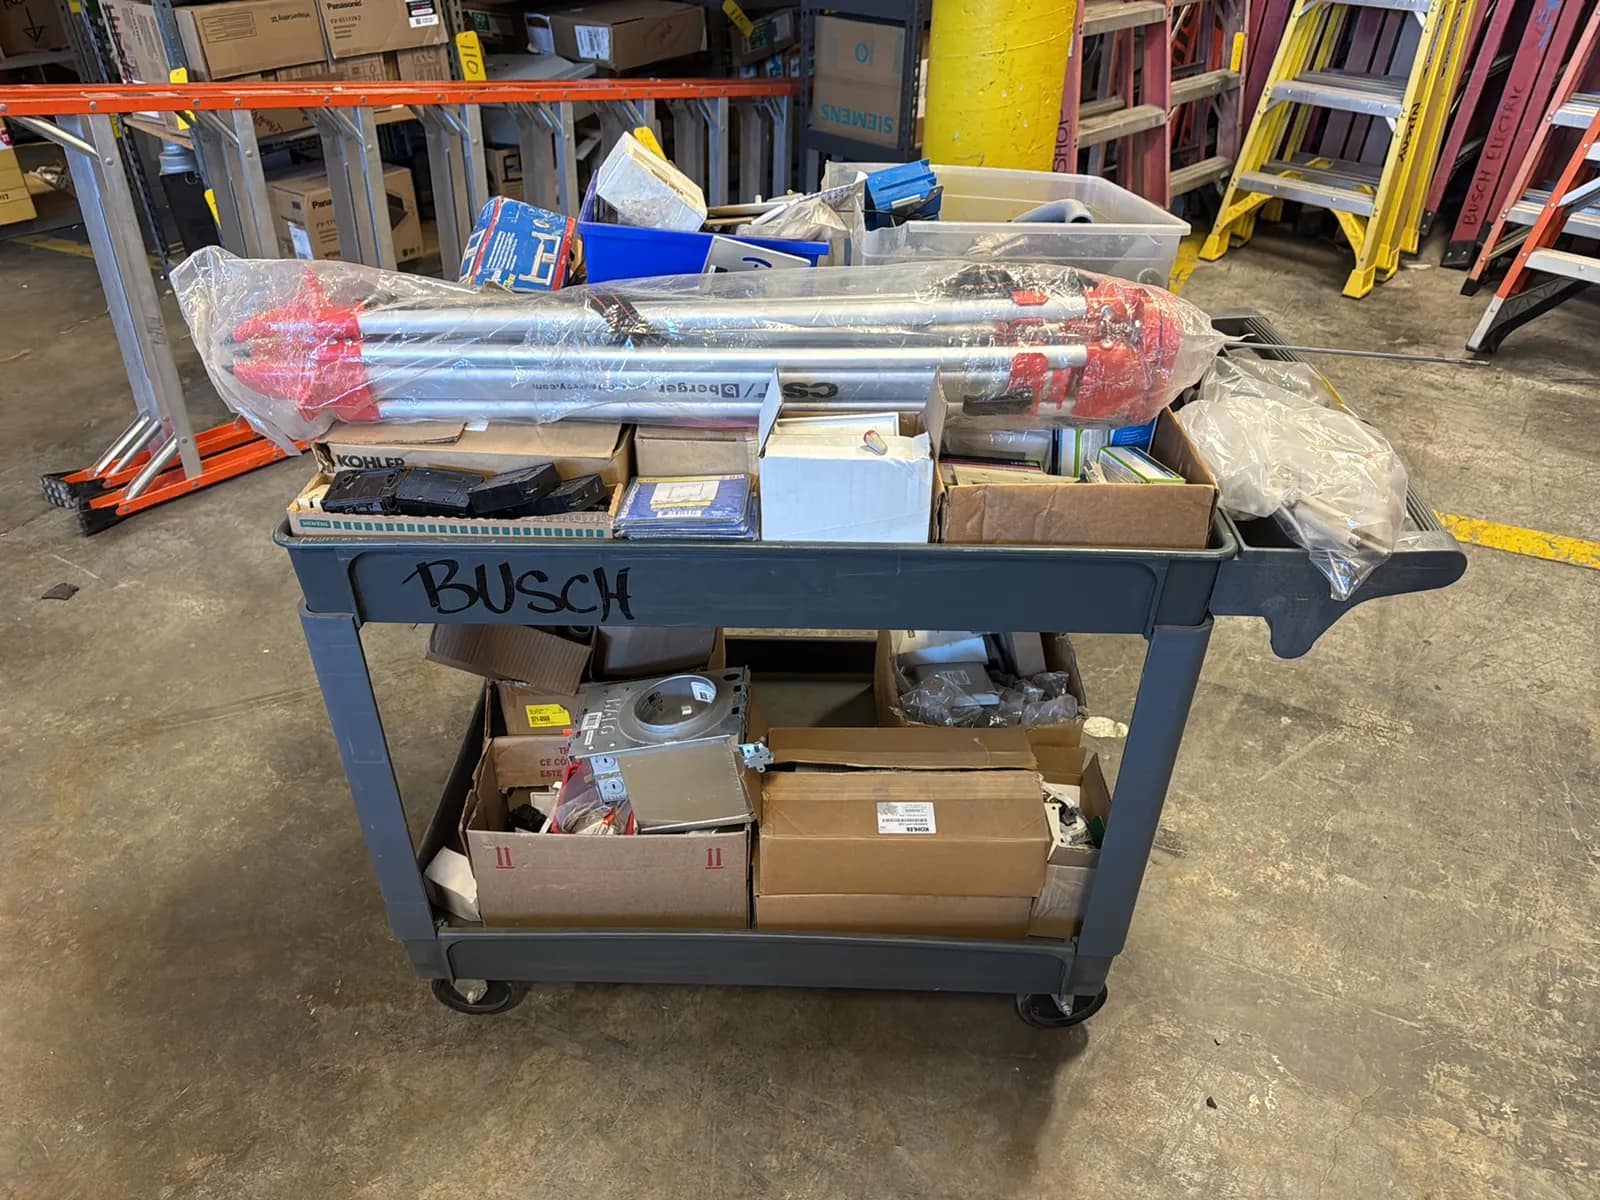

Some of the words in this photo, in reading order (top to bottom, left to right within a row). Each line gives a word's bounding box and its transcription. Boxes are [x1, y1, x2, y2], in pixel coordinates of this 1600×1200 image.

[327, 1, 362, 11] Panasonic
[820, 103, 894, 135] SIEMENS
[311, 198, 333, 209] Pana
[1464, 171, 1492, 226] BUSCH
[336, 454, 405, 470] KOHLER
[401, 559, 635, 622] BUSCH
[539, 758, 552, 767] CE
